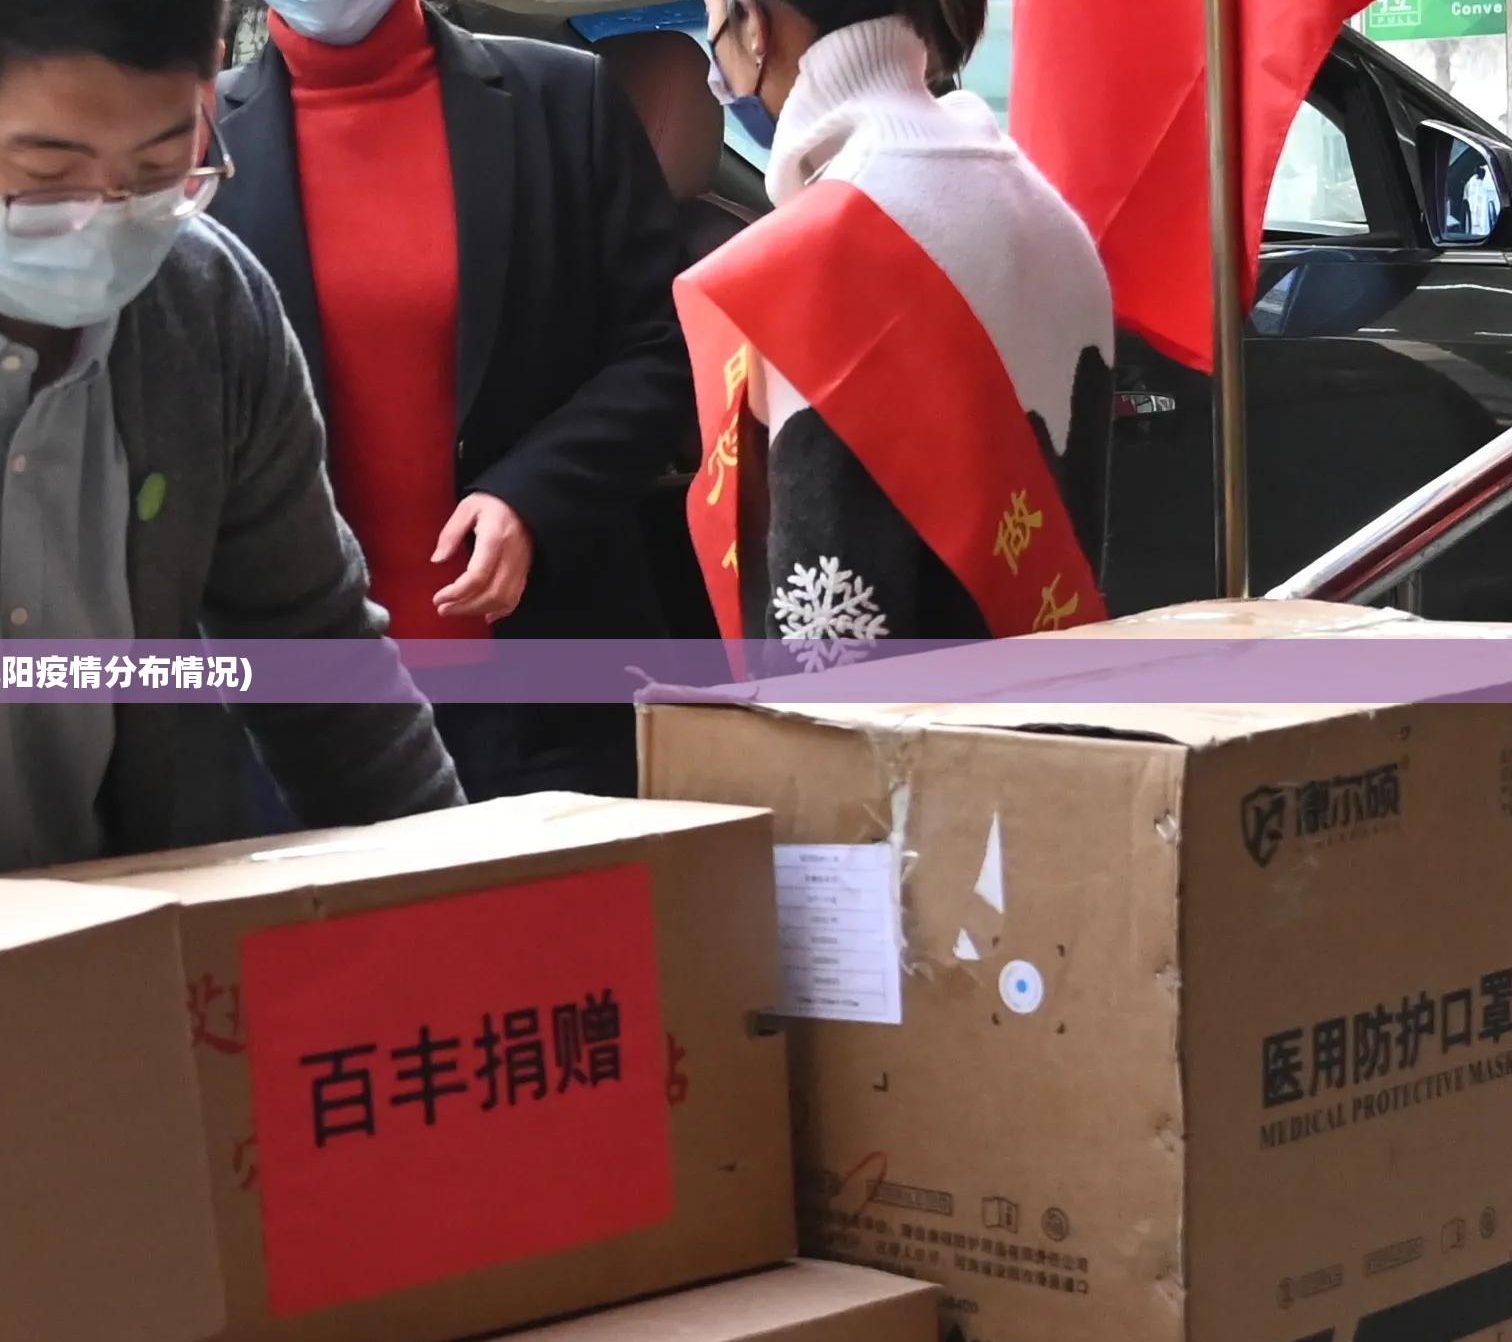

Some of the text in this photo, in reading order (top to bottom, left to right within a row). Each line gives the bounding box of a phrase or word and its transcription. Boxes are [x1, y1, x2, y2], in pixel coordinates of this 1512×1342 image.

[296, 987, 625, 1148] 百丰捐赠
[1259, 1107, 1347, 1151] MEDICAL
[1352, 1067, 1466, 1122] PROTECTIVE
